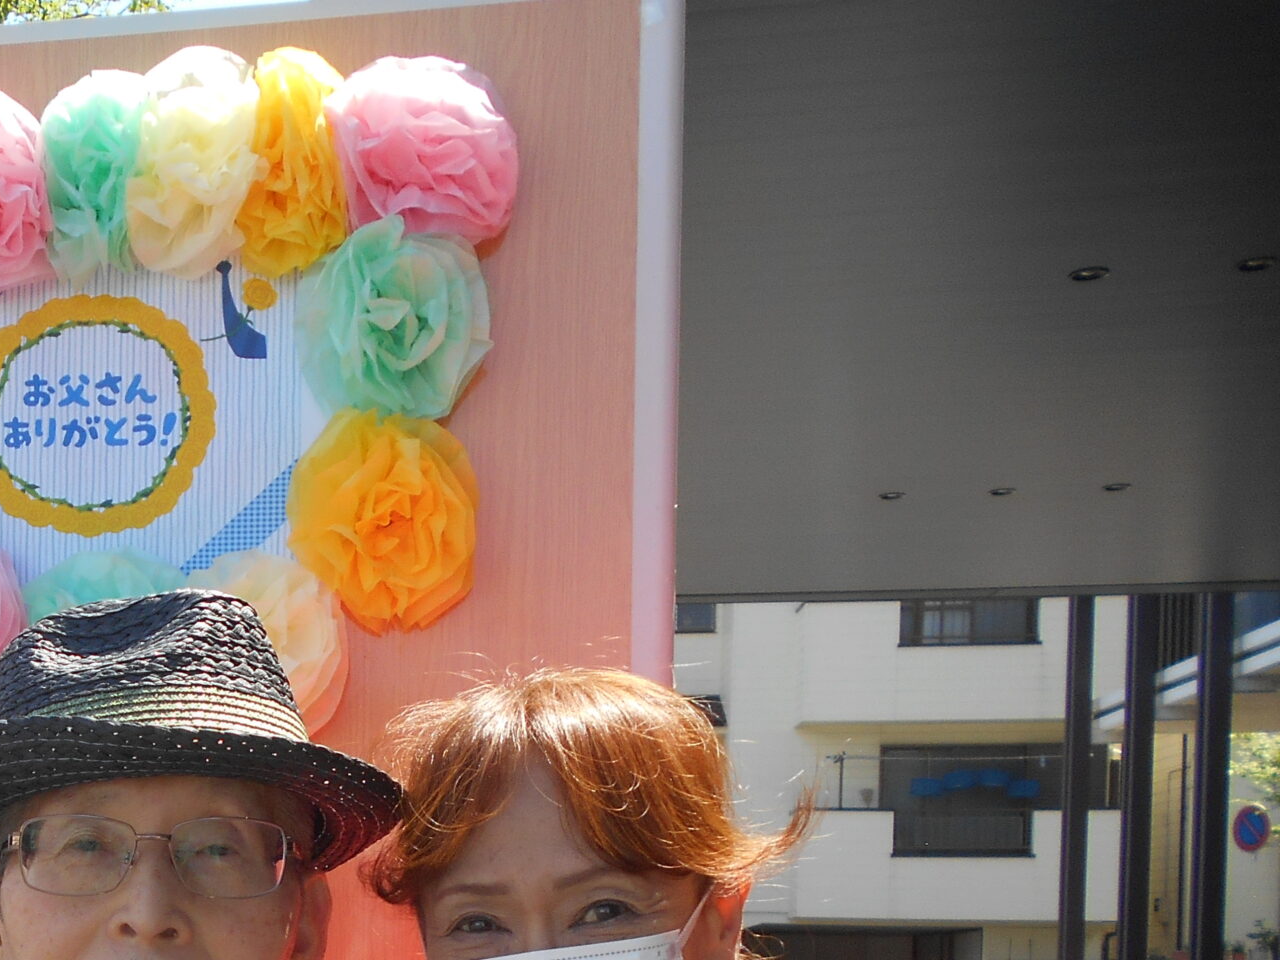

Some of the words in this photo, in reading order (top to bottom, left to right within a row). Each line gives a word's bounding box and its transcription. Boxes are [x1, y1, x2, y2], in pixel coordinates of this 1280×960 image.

[23, 372, 158, 408] お父さん
[3, 411, 178, 450] ありがとう!
